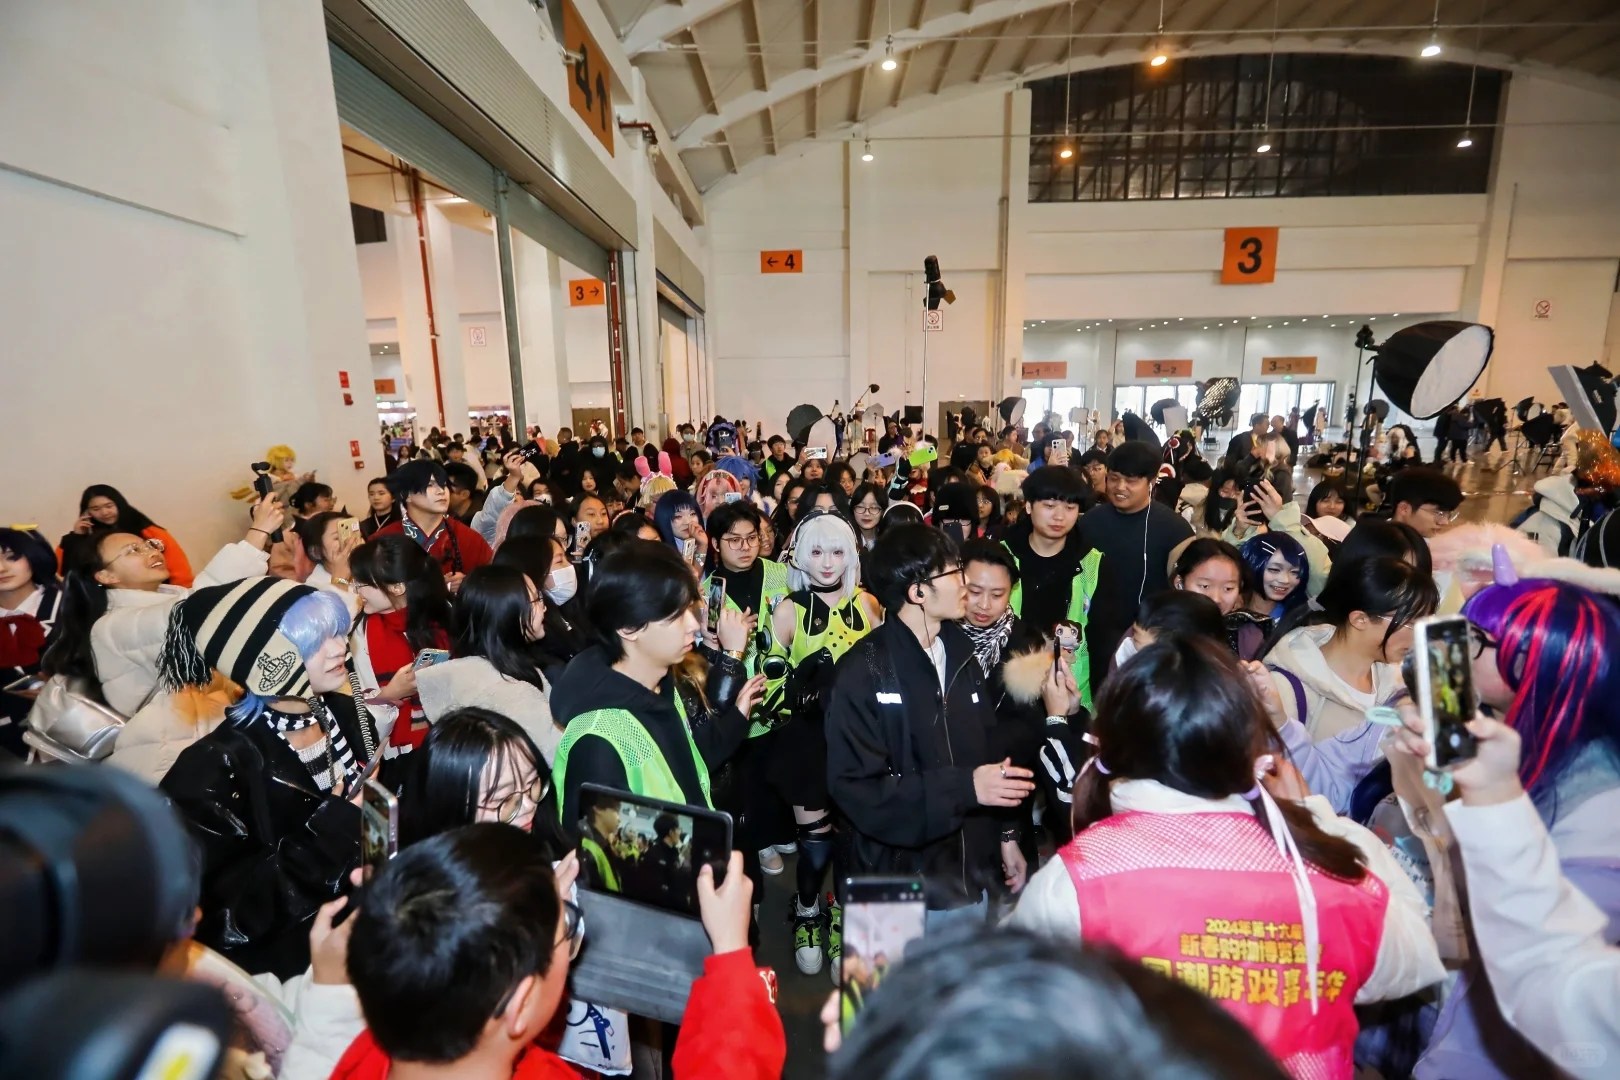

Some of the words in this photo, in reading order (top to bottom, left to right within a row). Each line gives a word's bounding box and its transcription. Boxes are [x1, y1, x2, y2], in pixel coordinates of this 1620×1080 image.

[575, 42, 592, 112] 4
[784, 254, 795, 269] 4
[1237, 236, 1263, 274] 3
[575, 286, 585, 301] 3
[1153, 363, 1177, 374] 3-2
